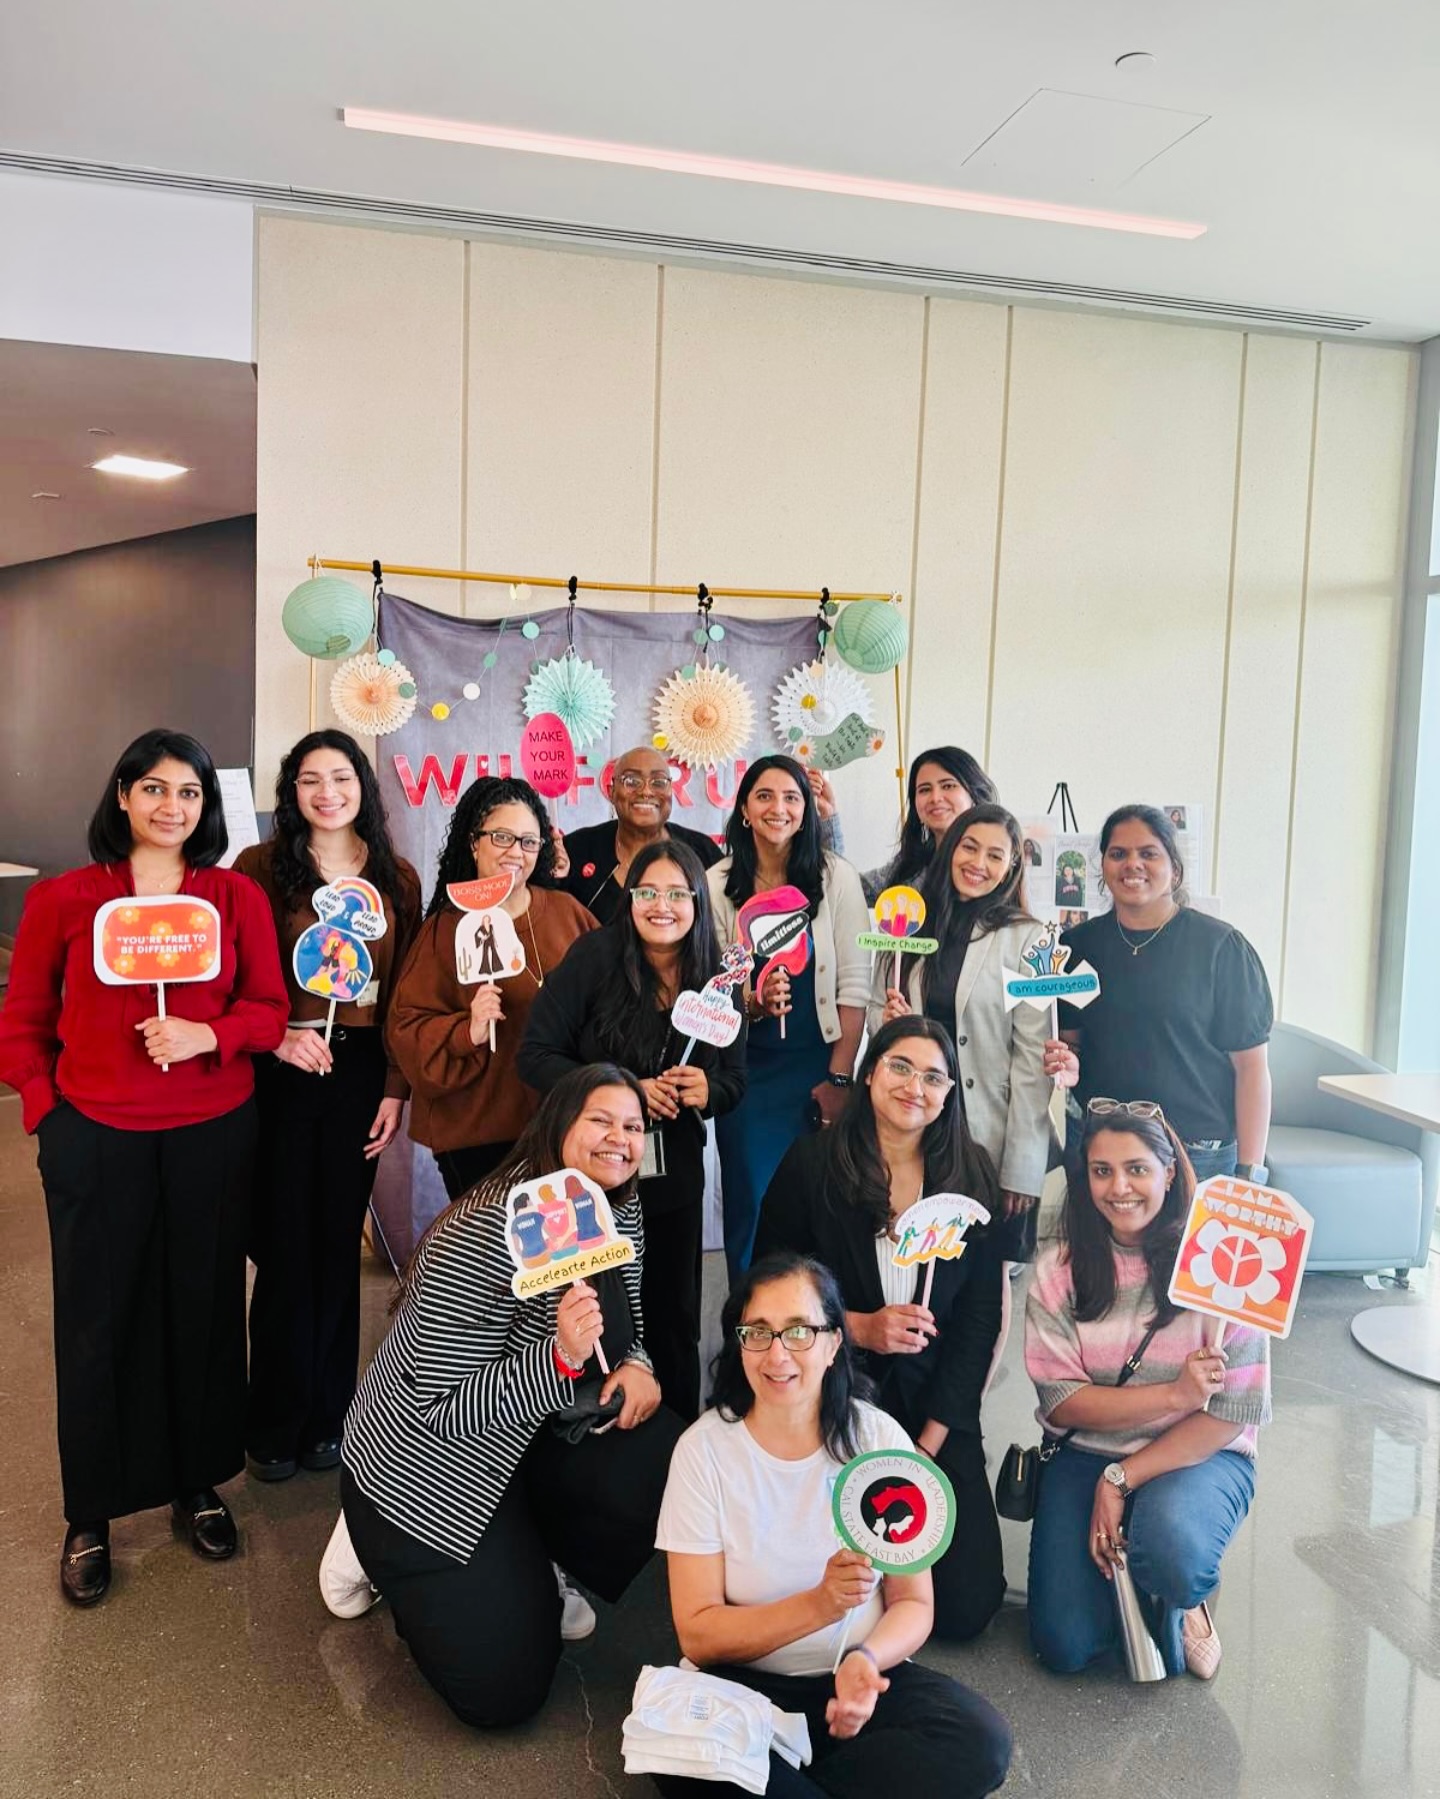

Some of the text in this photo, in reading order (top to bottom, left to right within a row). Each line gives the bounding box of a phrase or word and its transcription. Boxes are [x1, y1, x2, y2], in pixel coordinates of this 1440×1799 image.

[529, 730, 563, 743] MAKE
[530, 751, 565, 762] YOUR
[533, 769, 568, 781] MARK
[325, 891, 341, 903] LEAD
[453, 885, 482, 897] BOSS
[319, 899, 336, 912] LOUD
[361, 912, 378, 923] LEAD
[116, 934, 207, 944] "YOU'RE FREE TO
[760, 916, 804, 952] limitless
[121, 944, 203, 954] BE DIFFERENT."
[899, 939, 932, 952] Change
[1015, 985, 1032, 994] am
[1035, 980, 1096, 994] courageous
[703, 989, 730, 1009] Happy
[1225, 1181, 1273, 1207] I AM
[1205, 1196, 1299, 1236] WORTHY
[520, 1246, 630, 1292] Accelearte Action
[856, 1458, 947, 1549] WOMEN IN LEADERSHIP
[842, 1486, 915, 1563] CAL STATE EAST BAY
